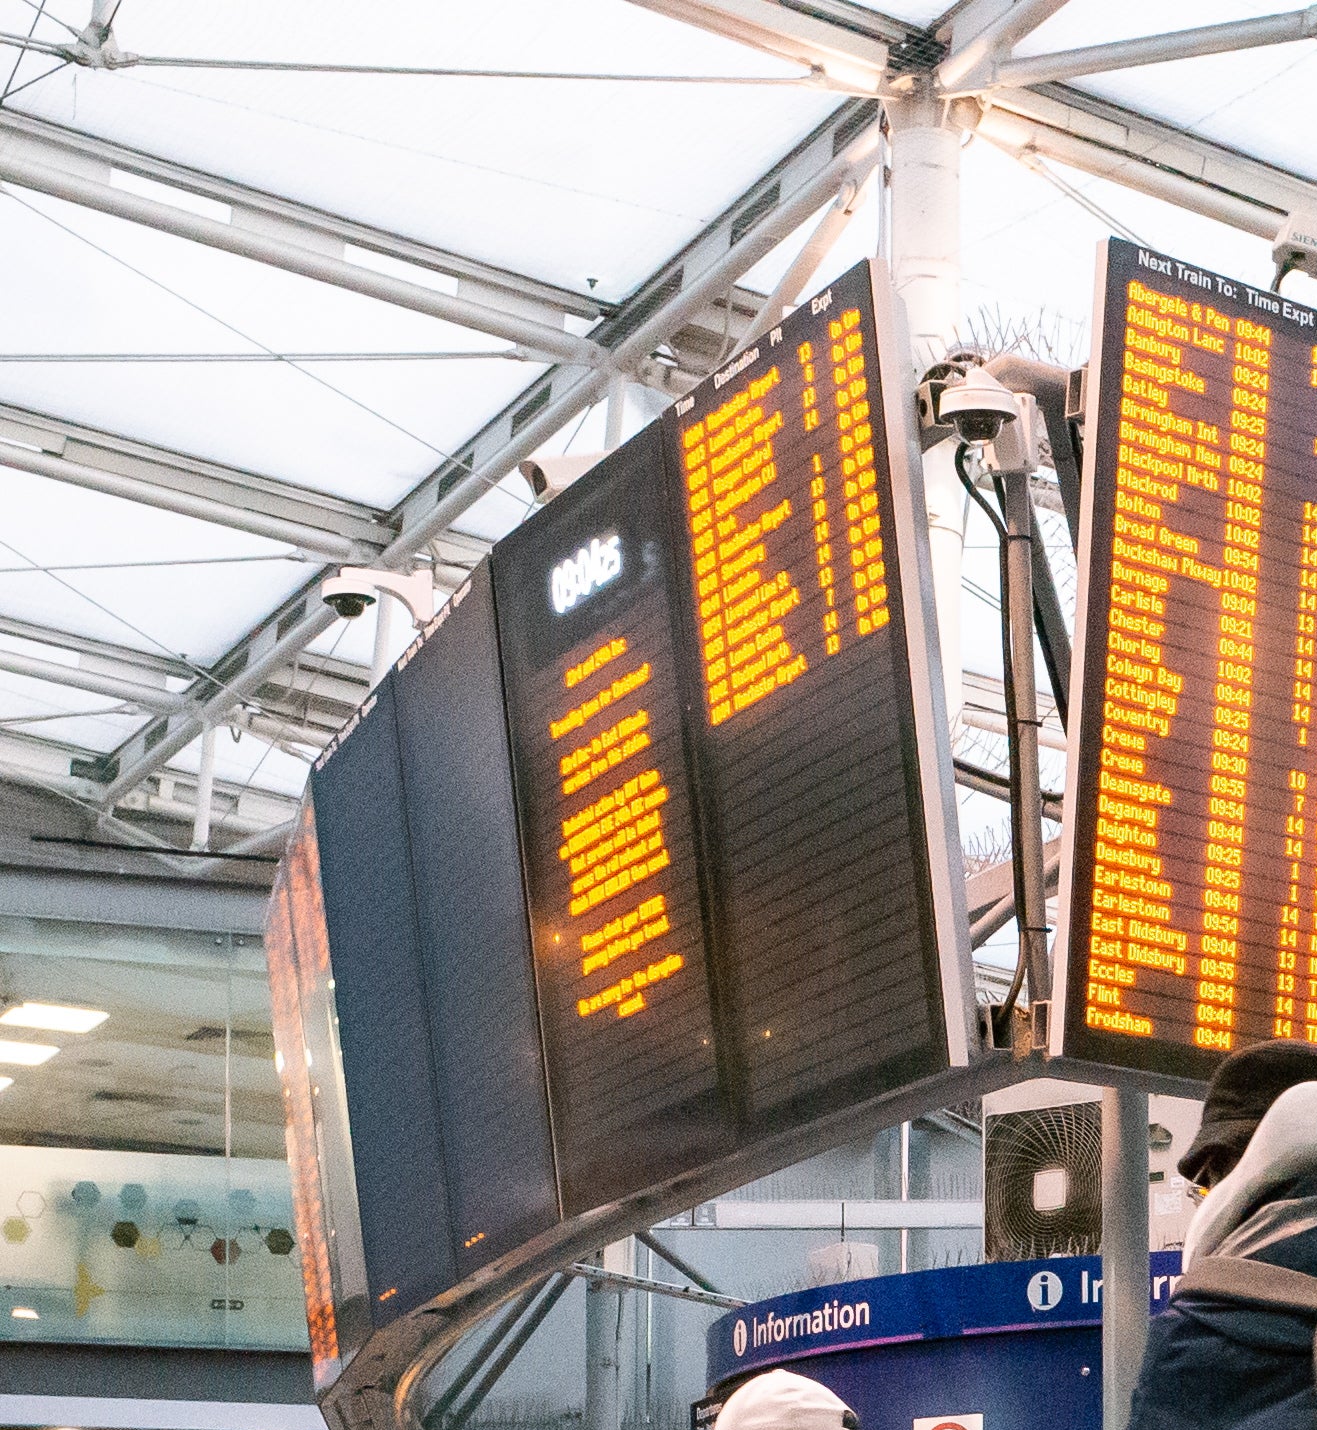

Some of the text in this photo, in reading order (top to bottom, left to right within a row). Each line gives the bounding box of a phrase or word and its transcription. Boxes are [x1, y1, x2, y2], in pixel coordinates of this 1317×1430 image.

[1127, 279, 1189, 319] Abergele
[1189, 301, 1203, 321] &
[1204, 306, 1231, 331] Pen
[1233, 317, 1272, 345] 09:44
[1138, 248, 1171, 275] Next
[1175, 262, 1211, 289] Train
[1215, 276, 1237, 298] To:
[1245, 287, 1279, 313] Time
[1282, 301, 1313, 326] Expt
[674, 396, 695, 417] Time
[714, 347, 760, 389] Destination
[811, 288, 833, 315] Expt
[1124, 325, 1182, 364] Banbury
[1231, 363, 1270, 390] 09:24
[1125, 303, 1191, 343] Adlington
[1191, 325, 1225, 353] Lanc
[1233, 340, 1271, 368] 10:02
[1121, 372, 1169, 406] Batley
[1229, 408, 1267, 435] 09:25
[1123, 349, 1205, 394] Basingstoke
[1229, 385, 1269, 413] 09:24
[1118, 419, 1193, 459] Birmingham
[1193, 442, 1222, 468] New
[1227, 453, 1264, 480] 09:24
[1120, 395, 1193, 437] Birmingham
[1195, 419, 1219, 444] Int
[1228, 431, 1265, 458] 09:24
[1115, 465, 1179, 501] Blackrod
[1225, 499, 1261, 526] 10:02
[1117, 443, 1185, 481] Blackpool
[1185, 463, 1219, 491] Nrth
[1226, 477, 1263, 503] 10:02
[1099, 769, 1172, 805] Deansgate
[1207, 795, 1246, 821] 09:54
[753, 1300, 870, 1348] Information
